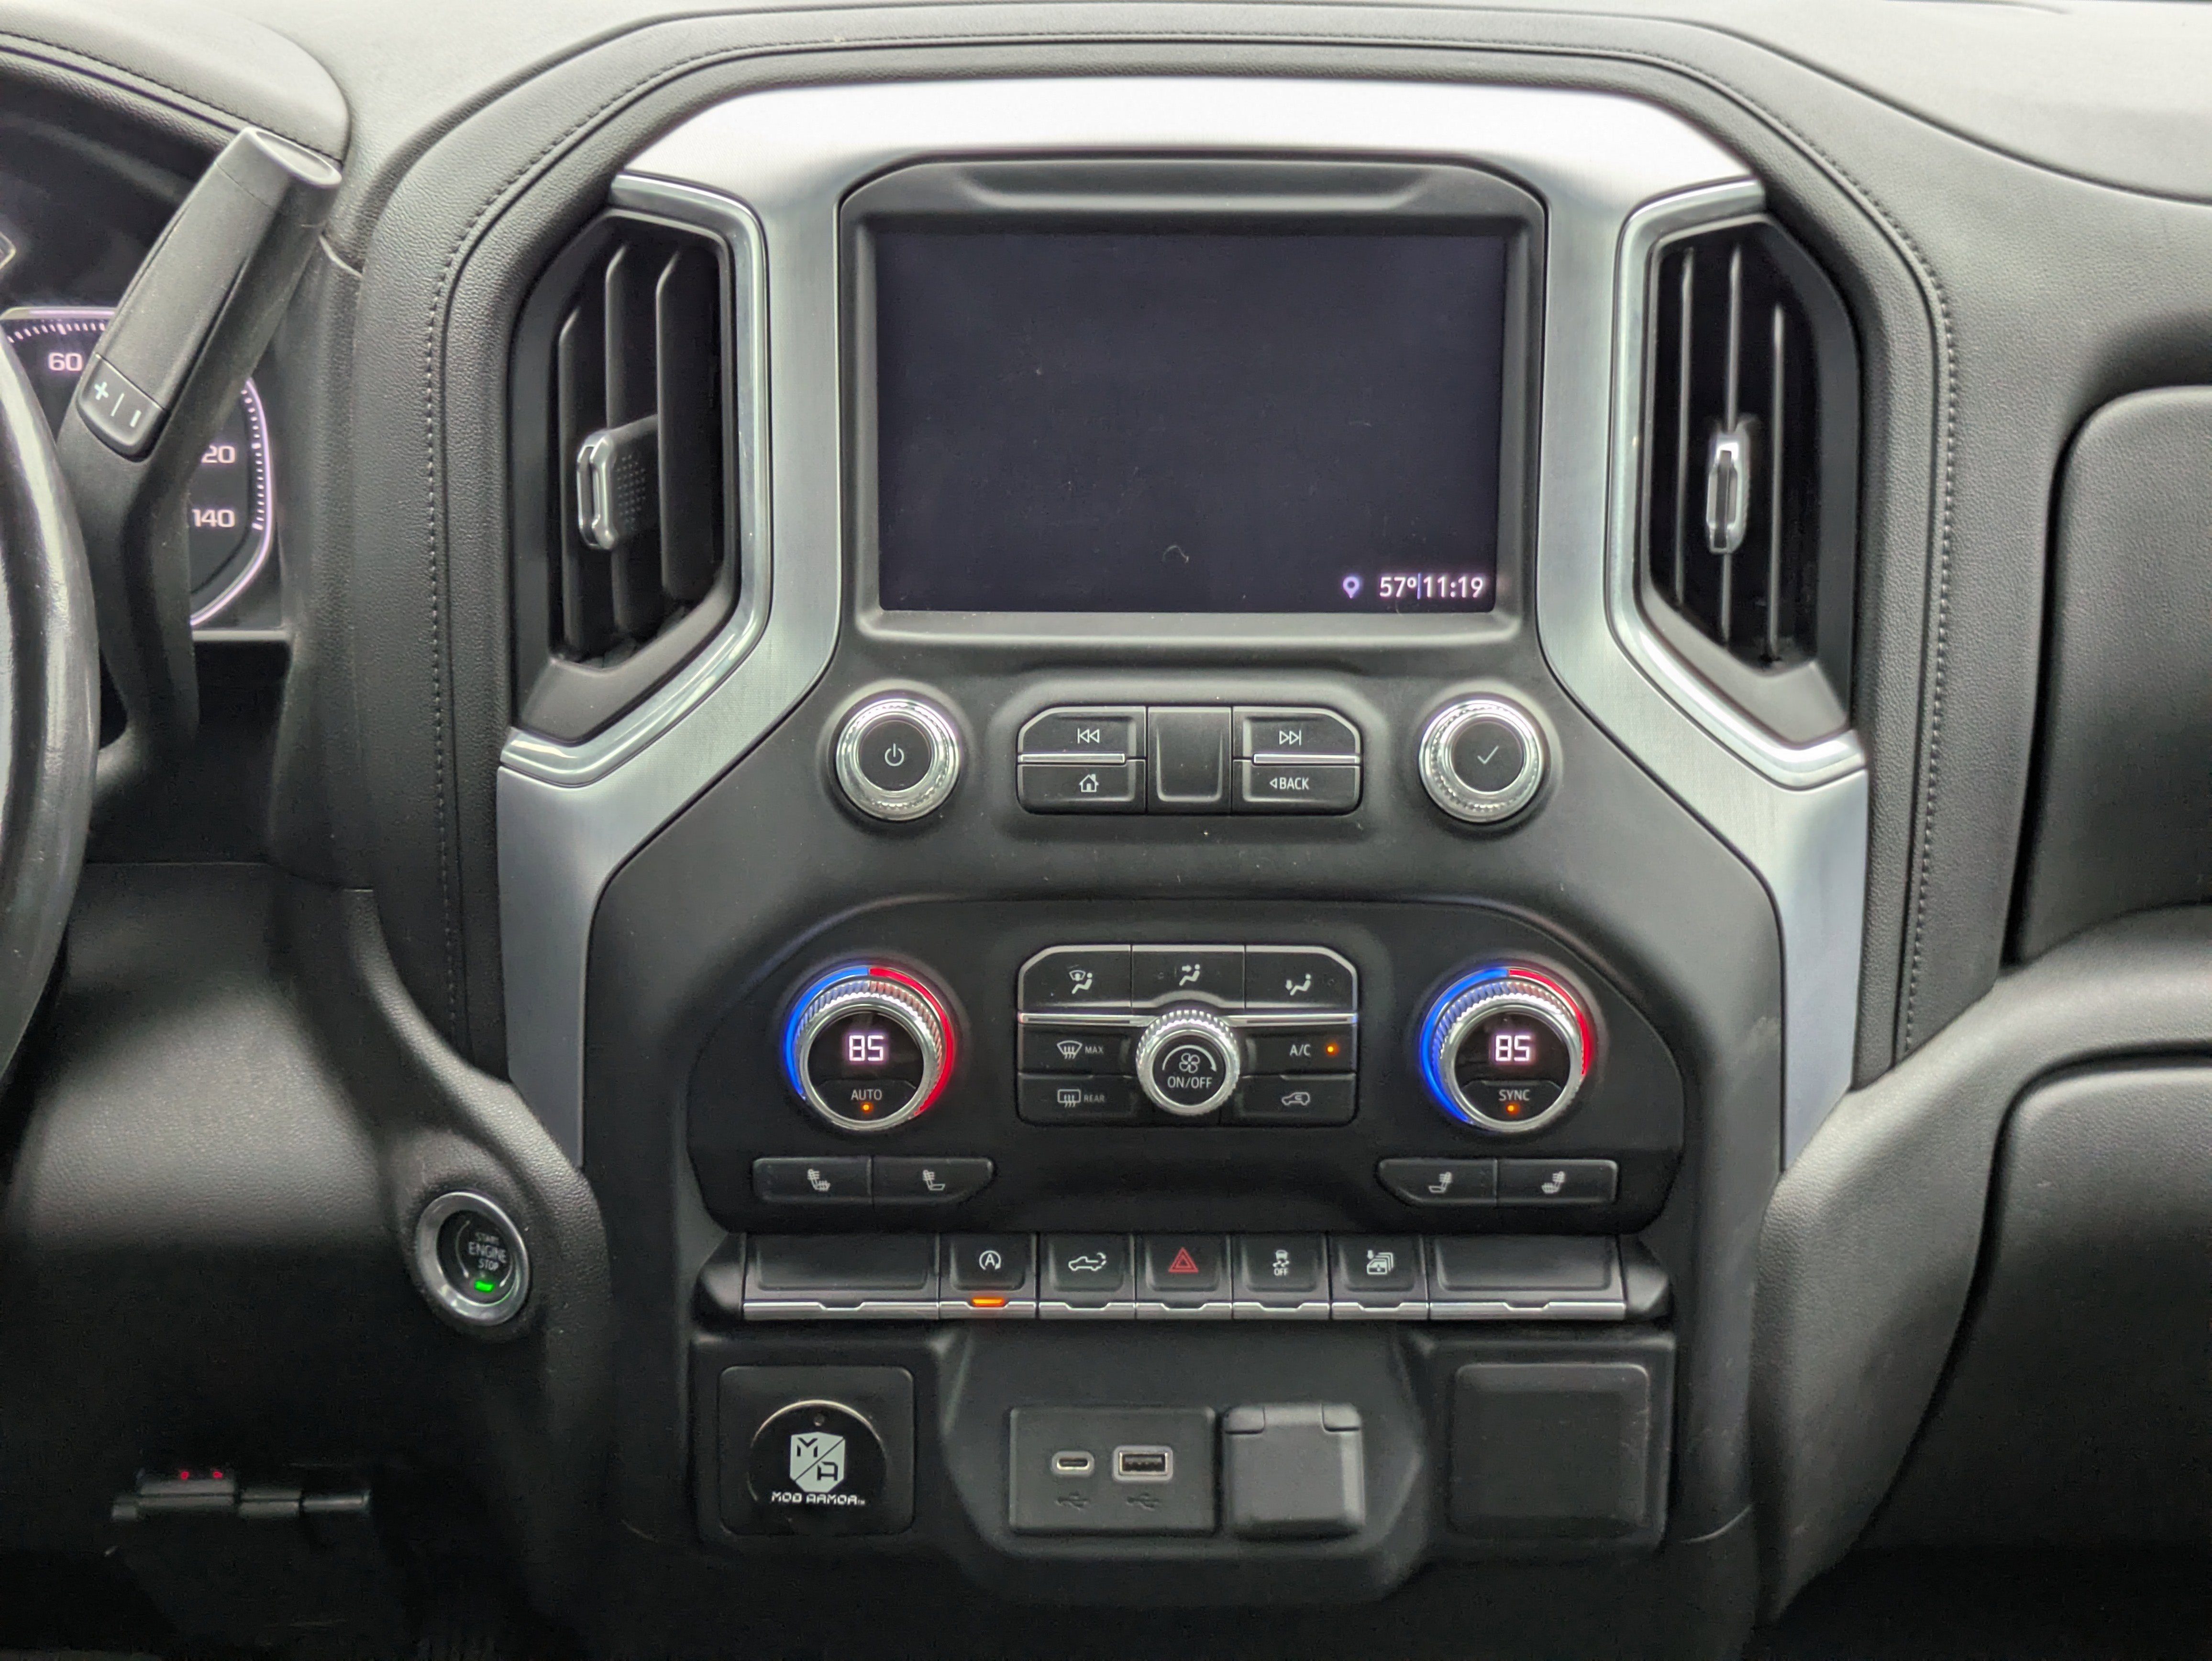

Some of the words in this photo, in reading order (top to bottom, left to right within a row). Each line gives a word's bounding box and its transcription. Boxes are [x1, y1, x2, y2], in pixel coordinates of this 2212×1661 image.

[49, 352, 83, 371] 60
[201, 445, 236, 464] 20
[192, 509, 235, 528] 140
[1423, 576, 1483, 598] 11:19
[1279, 777, 1309, 790] BACK
[849, 1035, 884, 1062] 85
[1085, 1046, 1104, 1054] MAX
[1290, 1044, 1311, 1057] A/C
[1495, 1035, 1530, 1062] 85
[1167, 1076, 1213, 1089] ON/OFF
[851, 1089, 882, 1100] AUTO
[1084, 1094, 1106, 1103] REAR
[1498, 1089, 1530, 1101] SYNC
[1274, 1268, 1288, 1276] OFF
[772, 1491, 802, 1504] MOD
